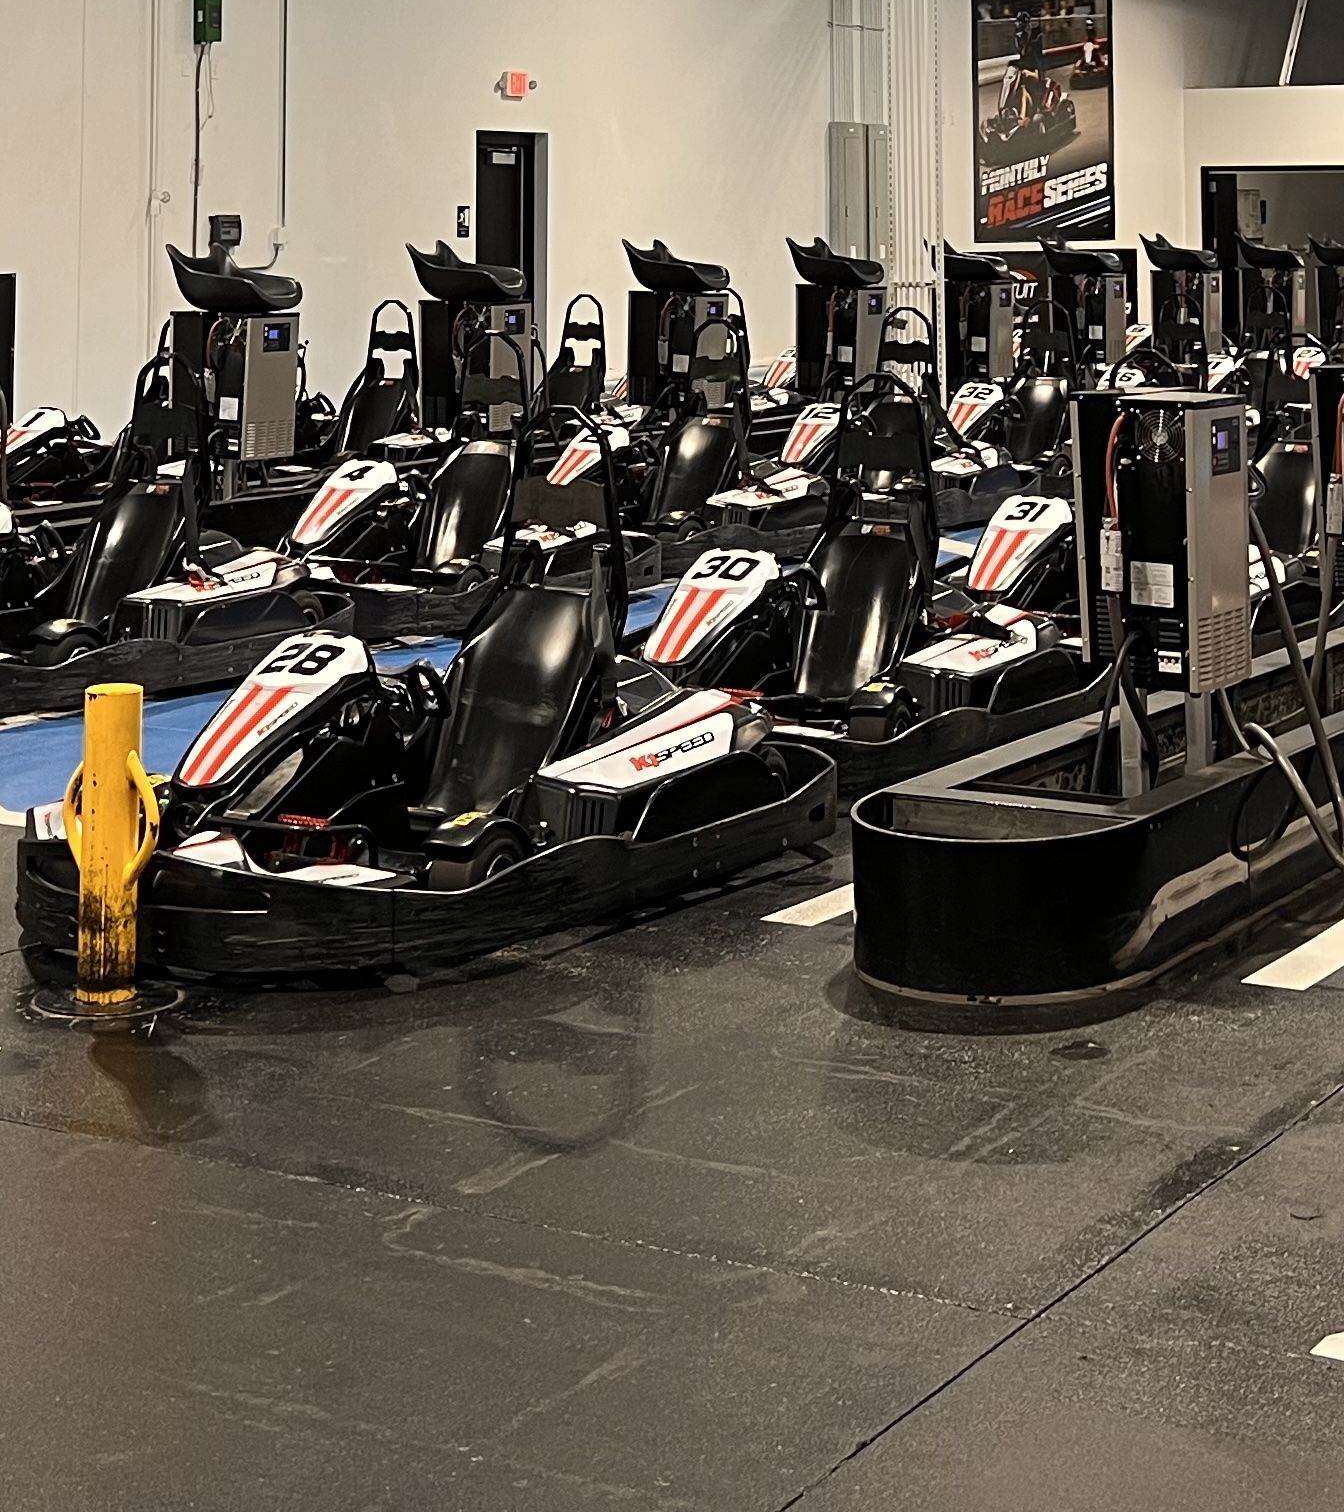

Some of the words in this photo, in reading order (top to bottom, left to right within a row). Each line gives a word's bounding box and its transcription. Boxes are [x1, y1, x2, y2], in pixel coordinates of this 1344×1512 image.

[981, 154, 1050, 196] MONTHLY
[987, 181, 1044, 228] RACE
[1043, 162, 1108, 208] SERIES
[959, 386, 995, 400] 32
[21, 411, 46, 427] 1
[804, 404, 838, 420] 12
[340, 465, 376, 481] 4
[1004, 501, 1052, 523] 31
[690, 555, 761, 582] 30
[256, 643, 346, 676] 28
